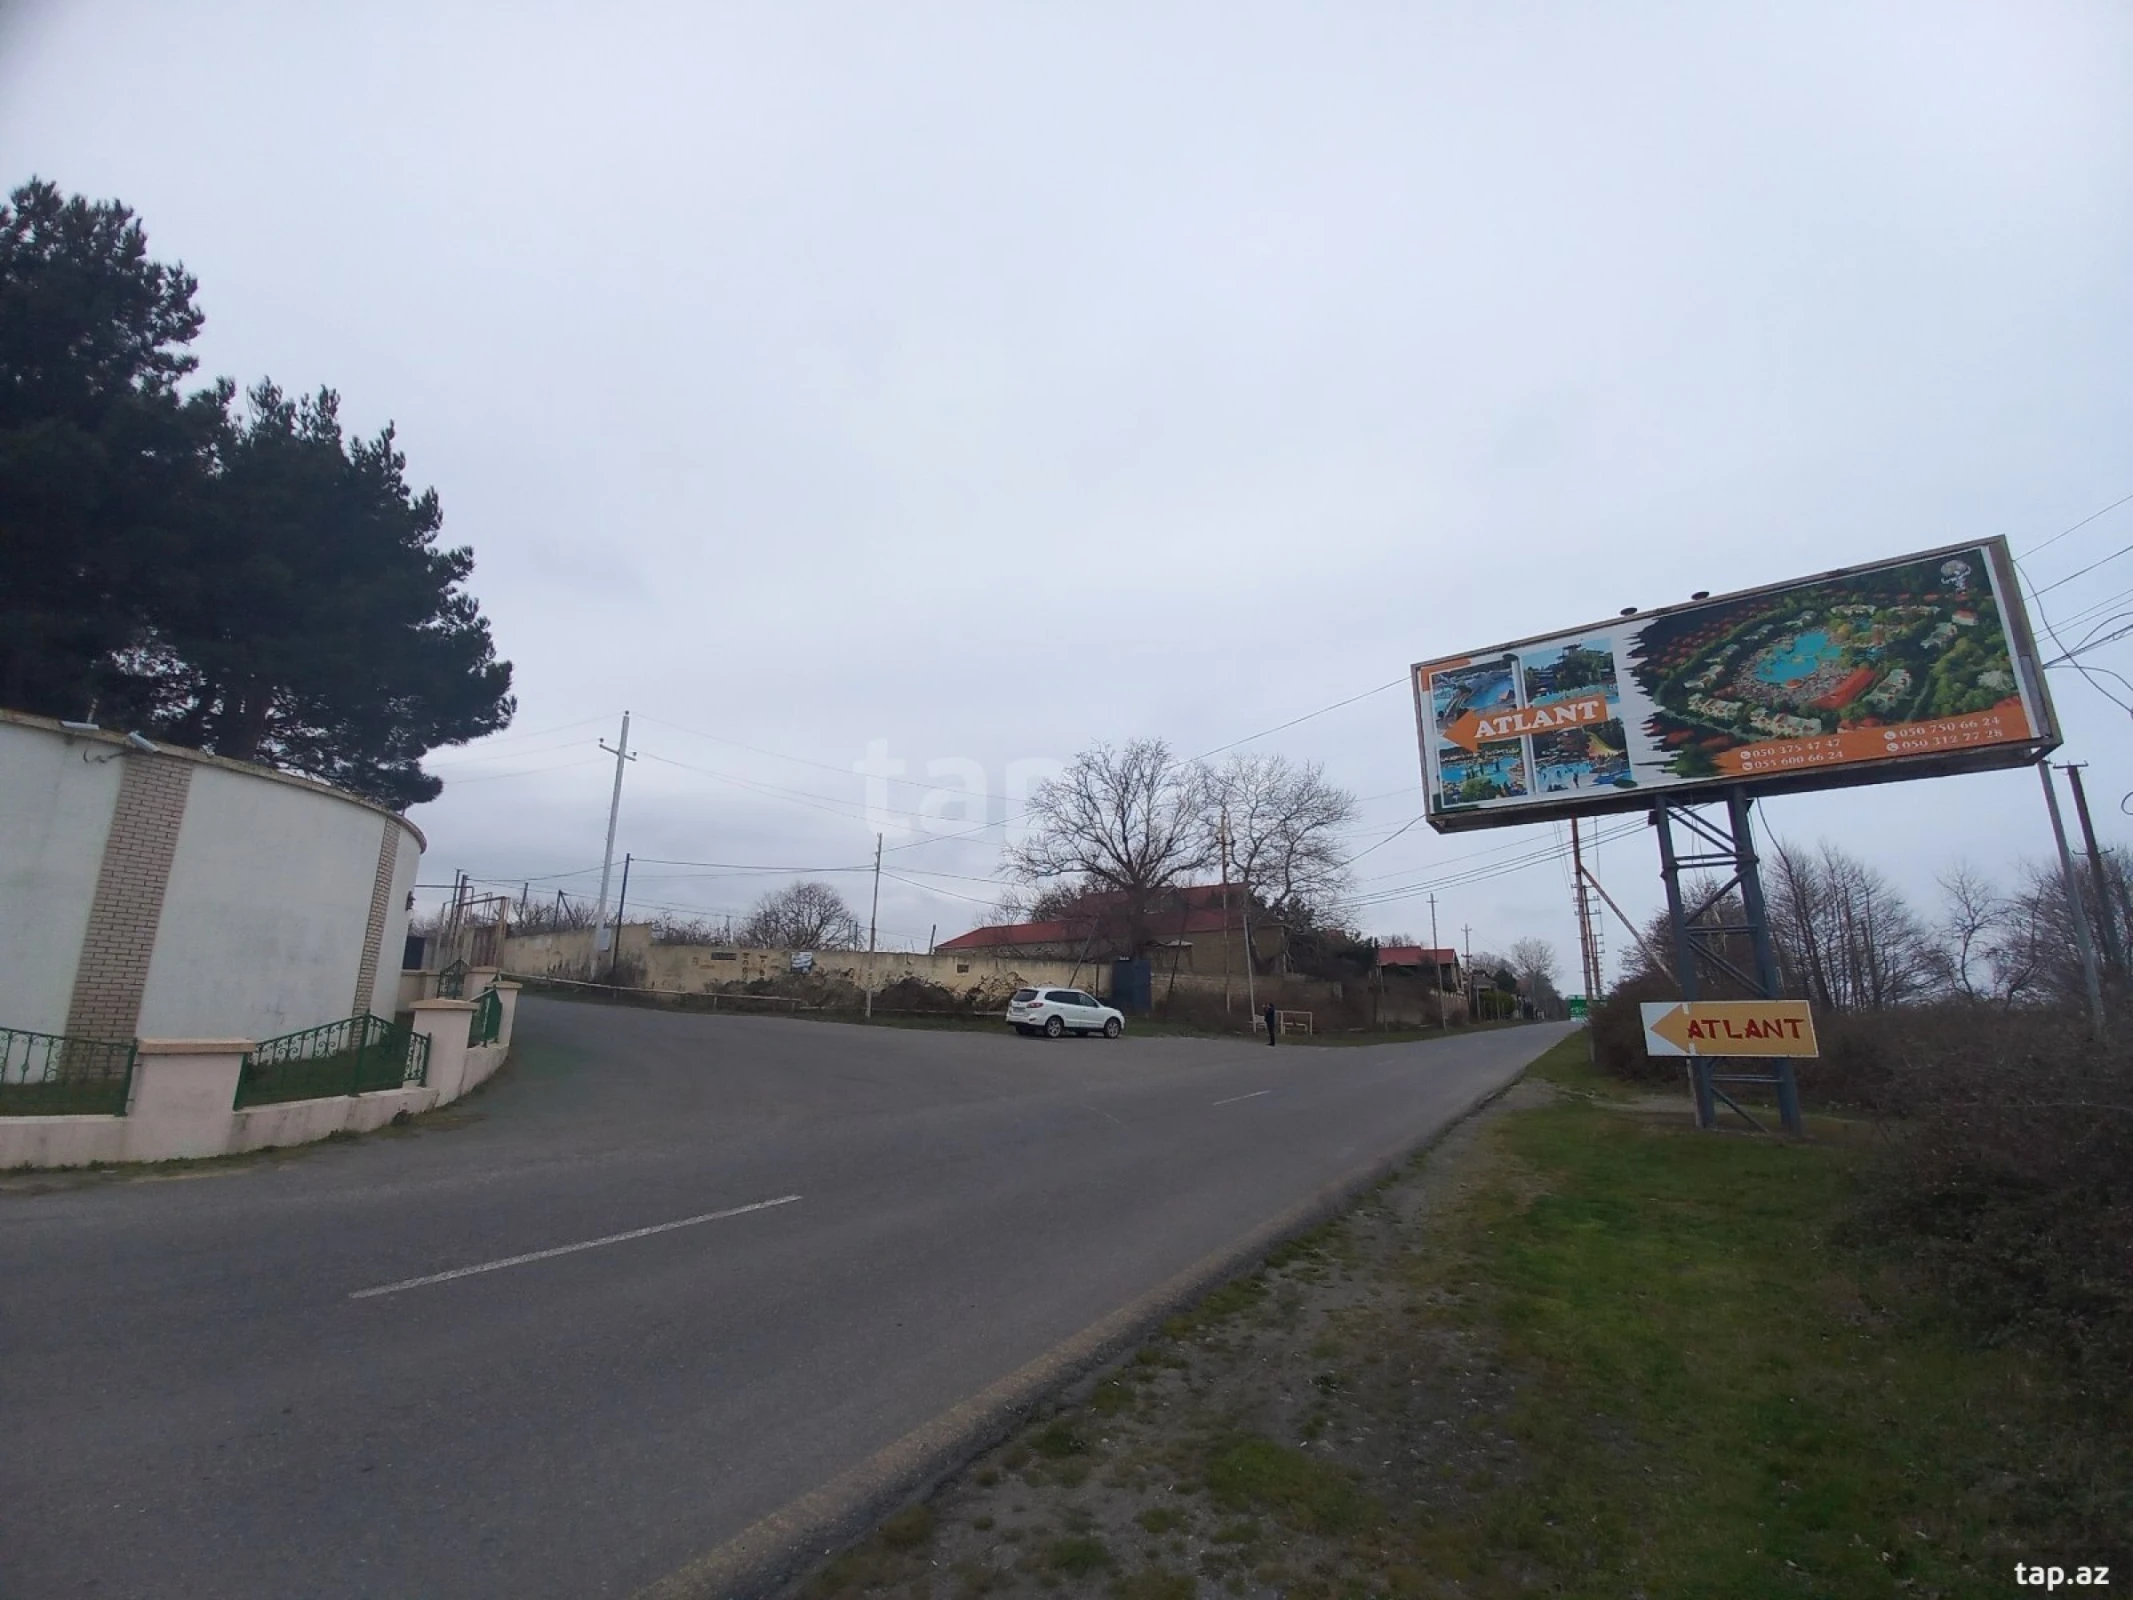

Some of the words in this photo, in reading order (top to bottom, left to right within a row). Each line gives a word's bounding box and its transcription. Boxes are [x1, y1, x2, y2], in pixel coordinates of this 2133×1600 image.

[1474, 700, 1600, 738] ATLANT
[1899, 727, 1926, 737] 050
[1930, 722, 1955, 734] 750
[1960, 720, 1978, 729] 66
[1982, 716, 2001, 726] 24
[1902, 739, 1929, 749] 050
[1932, 735, 1958, 746] 312
[1963, 732, 1980, 741] 77
[1753, 748, 1775, 758] 050
[1779, 744, 1802, 754] 375
[1781, 755, 1804, 766] 600
[1808, 753, 1824, 762] 66
[1828, 751, 1844, 759] 24
[1687, 1018, 1805, 1040] ATLANT
